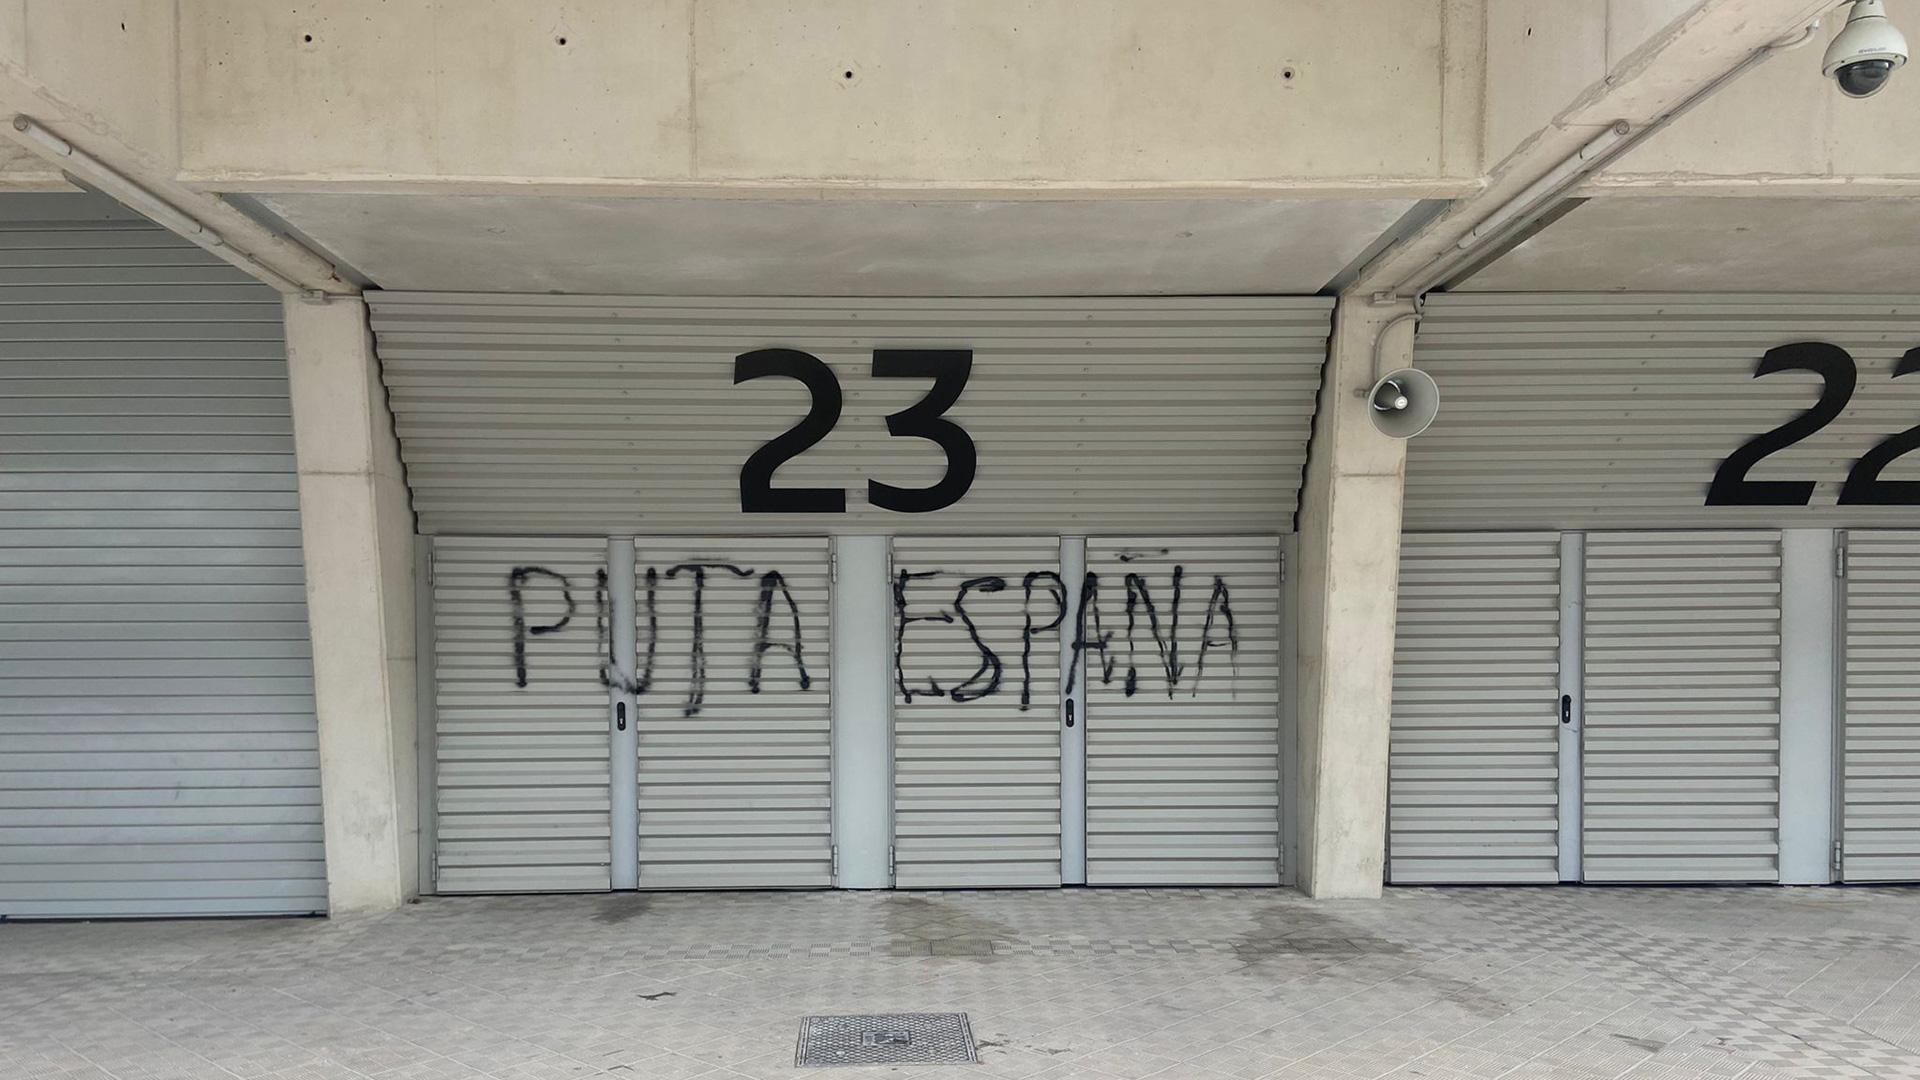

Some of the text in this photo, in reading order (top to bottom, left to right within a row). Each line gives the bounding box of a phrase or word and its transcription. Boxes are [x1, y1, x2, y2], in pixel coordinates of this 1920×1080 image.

[734, 348, 976, 513] 23
[1705, 342, 1920, 506] 22
[509, 547, 1240, 718] PUTA ESPAÑA
